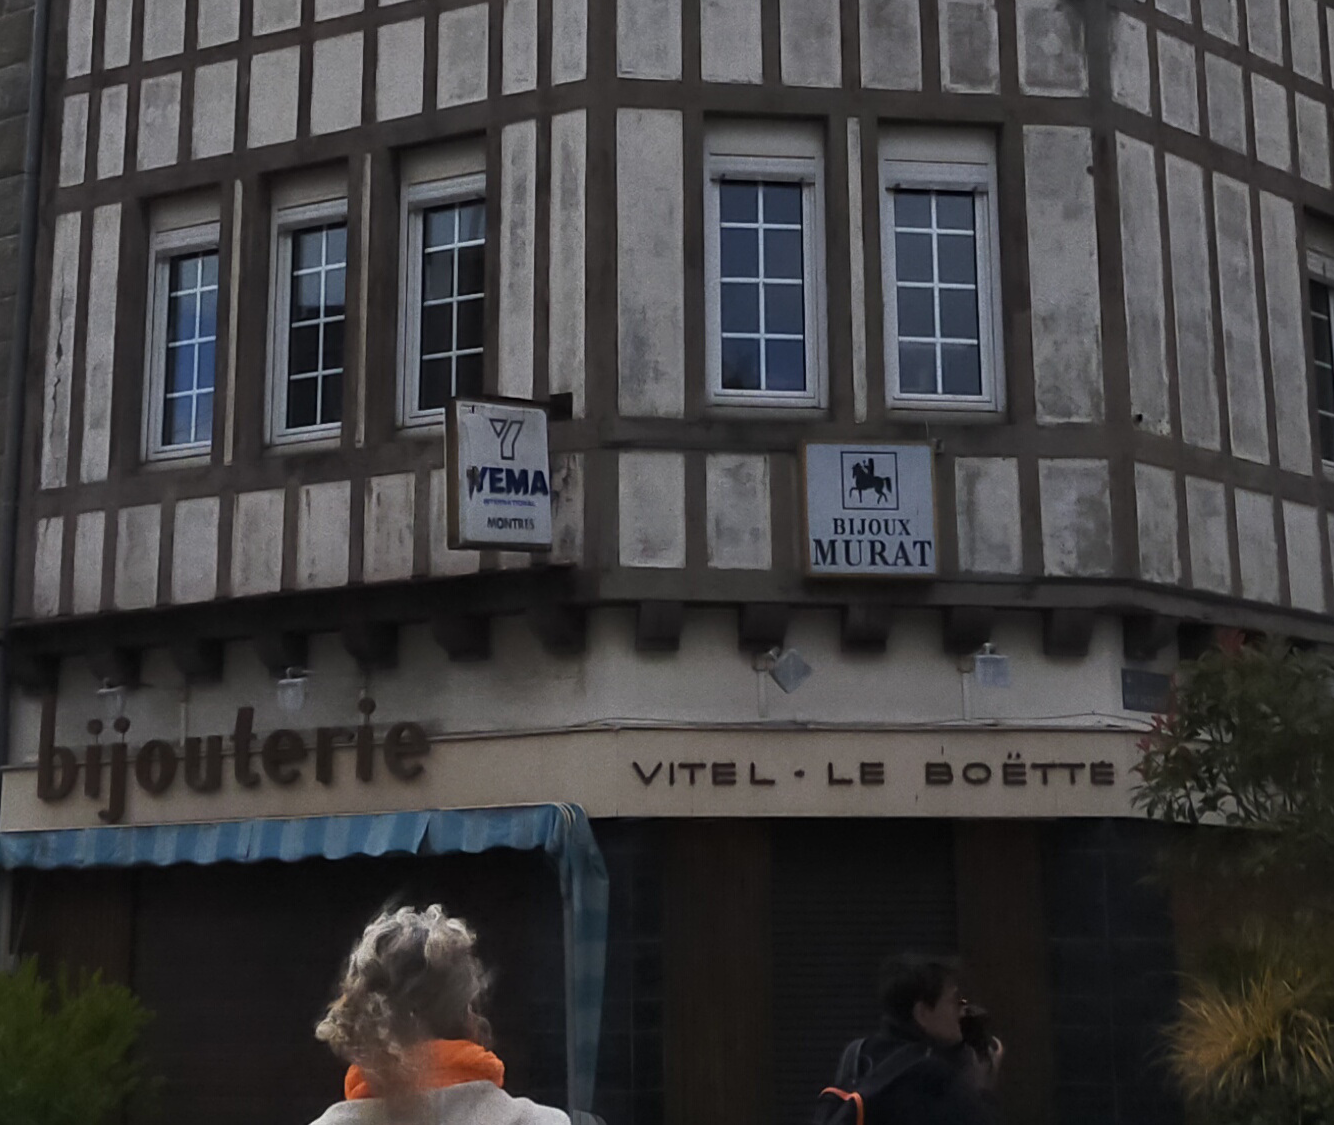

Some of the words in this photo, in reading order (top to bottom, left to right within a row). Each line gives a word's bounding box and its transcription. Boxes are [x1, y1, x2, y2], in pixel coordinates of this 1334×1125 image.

[487, 516, 535, 530] MONTRES
[832, 517, 911, 536] BIJOUX
[812, 538, 932, 567] MURAT
[37, 691, 431, 824] bijouterie
[632, 762, 775, 786] VITEL
[828, 762, 885, 786] LE
[925, 752, 1115, 786] BOËTTE
